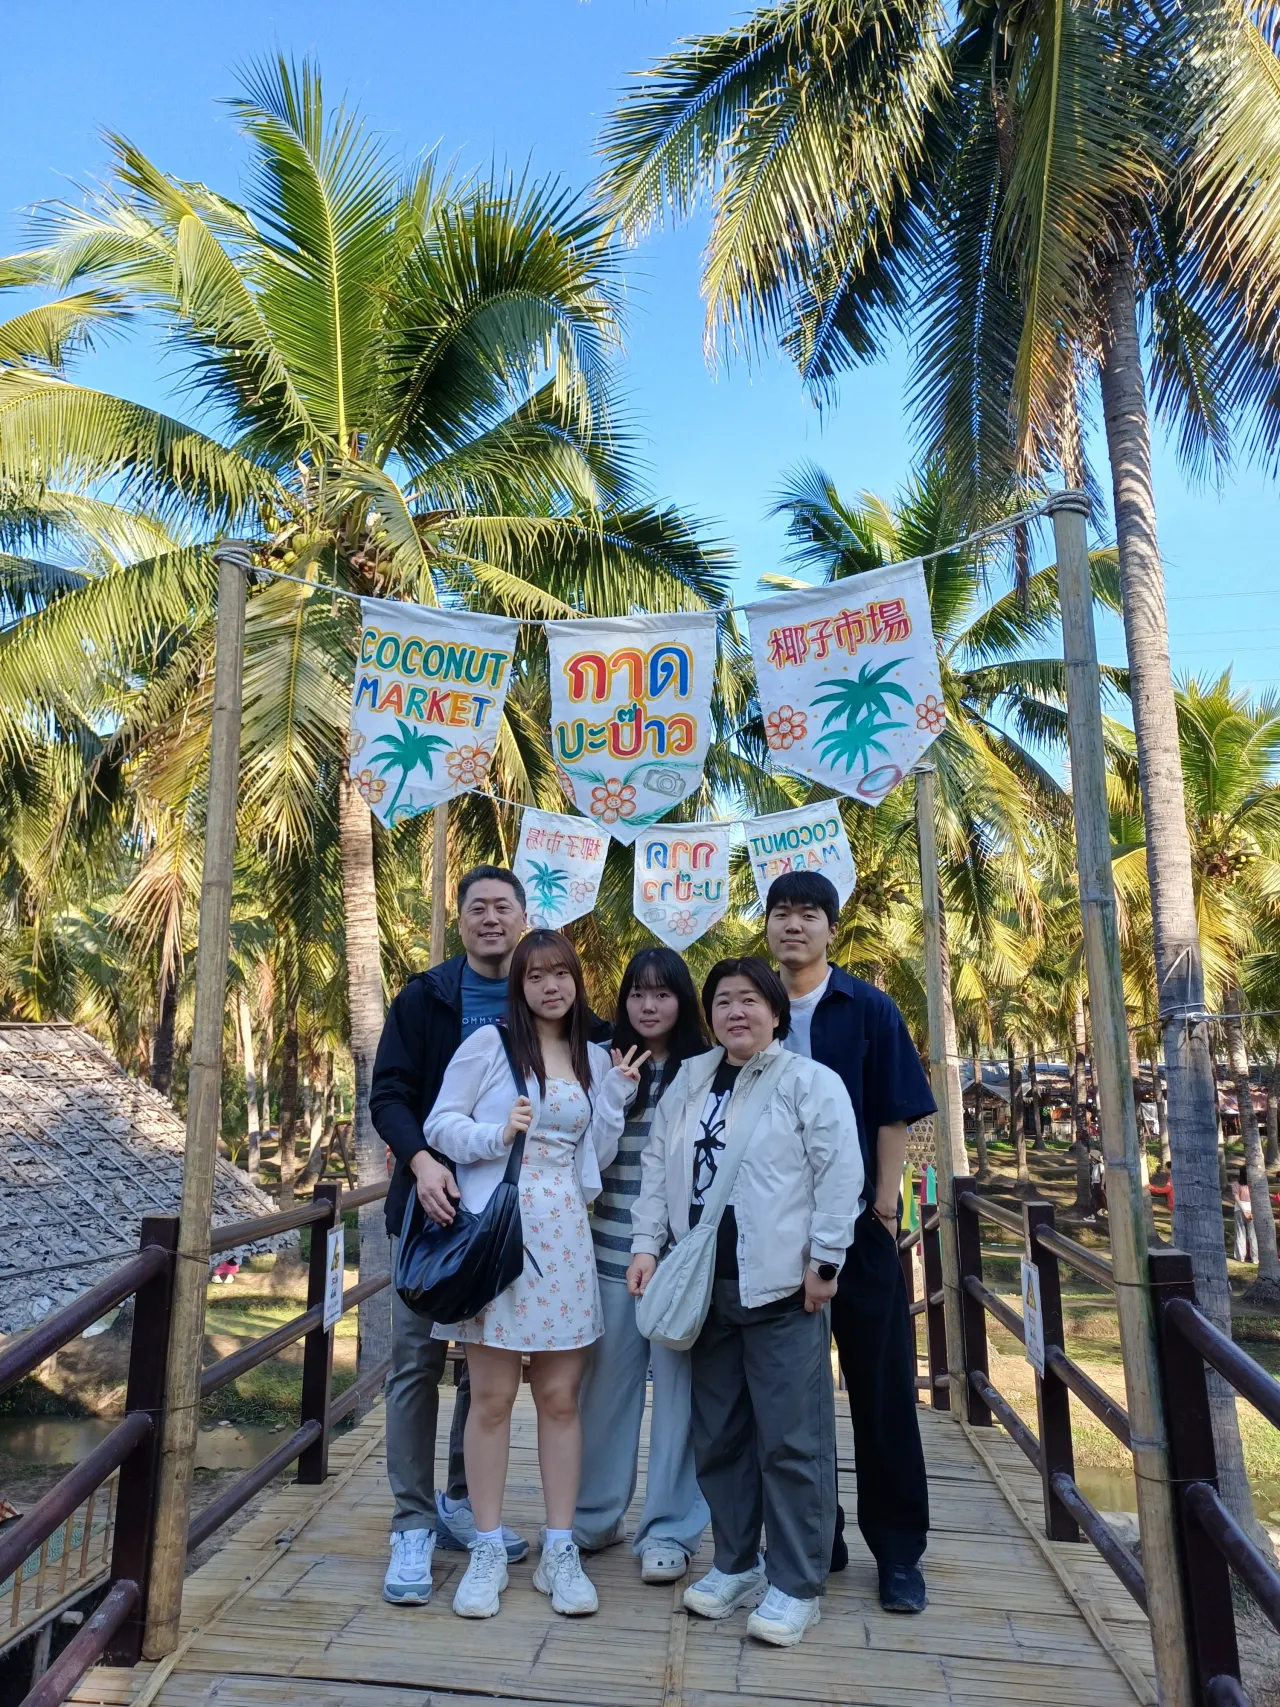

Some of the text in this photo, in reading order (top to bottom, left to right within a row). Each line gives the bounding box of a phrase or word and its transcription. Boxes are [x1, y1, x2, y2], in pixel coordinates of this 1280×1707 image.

[360, 629, 511, 688] COCONUT
[769, 599, 911, 669] 椰子市場
[567, 645, 690, 699] กาด
[355, 676, 493, 728] MARKET
[557, 702, 693, 760] บะป๊าว
[461, 1016, 493, 1025] OMMY
